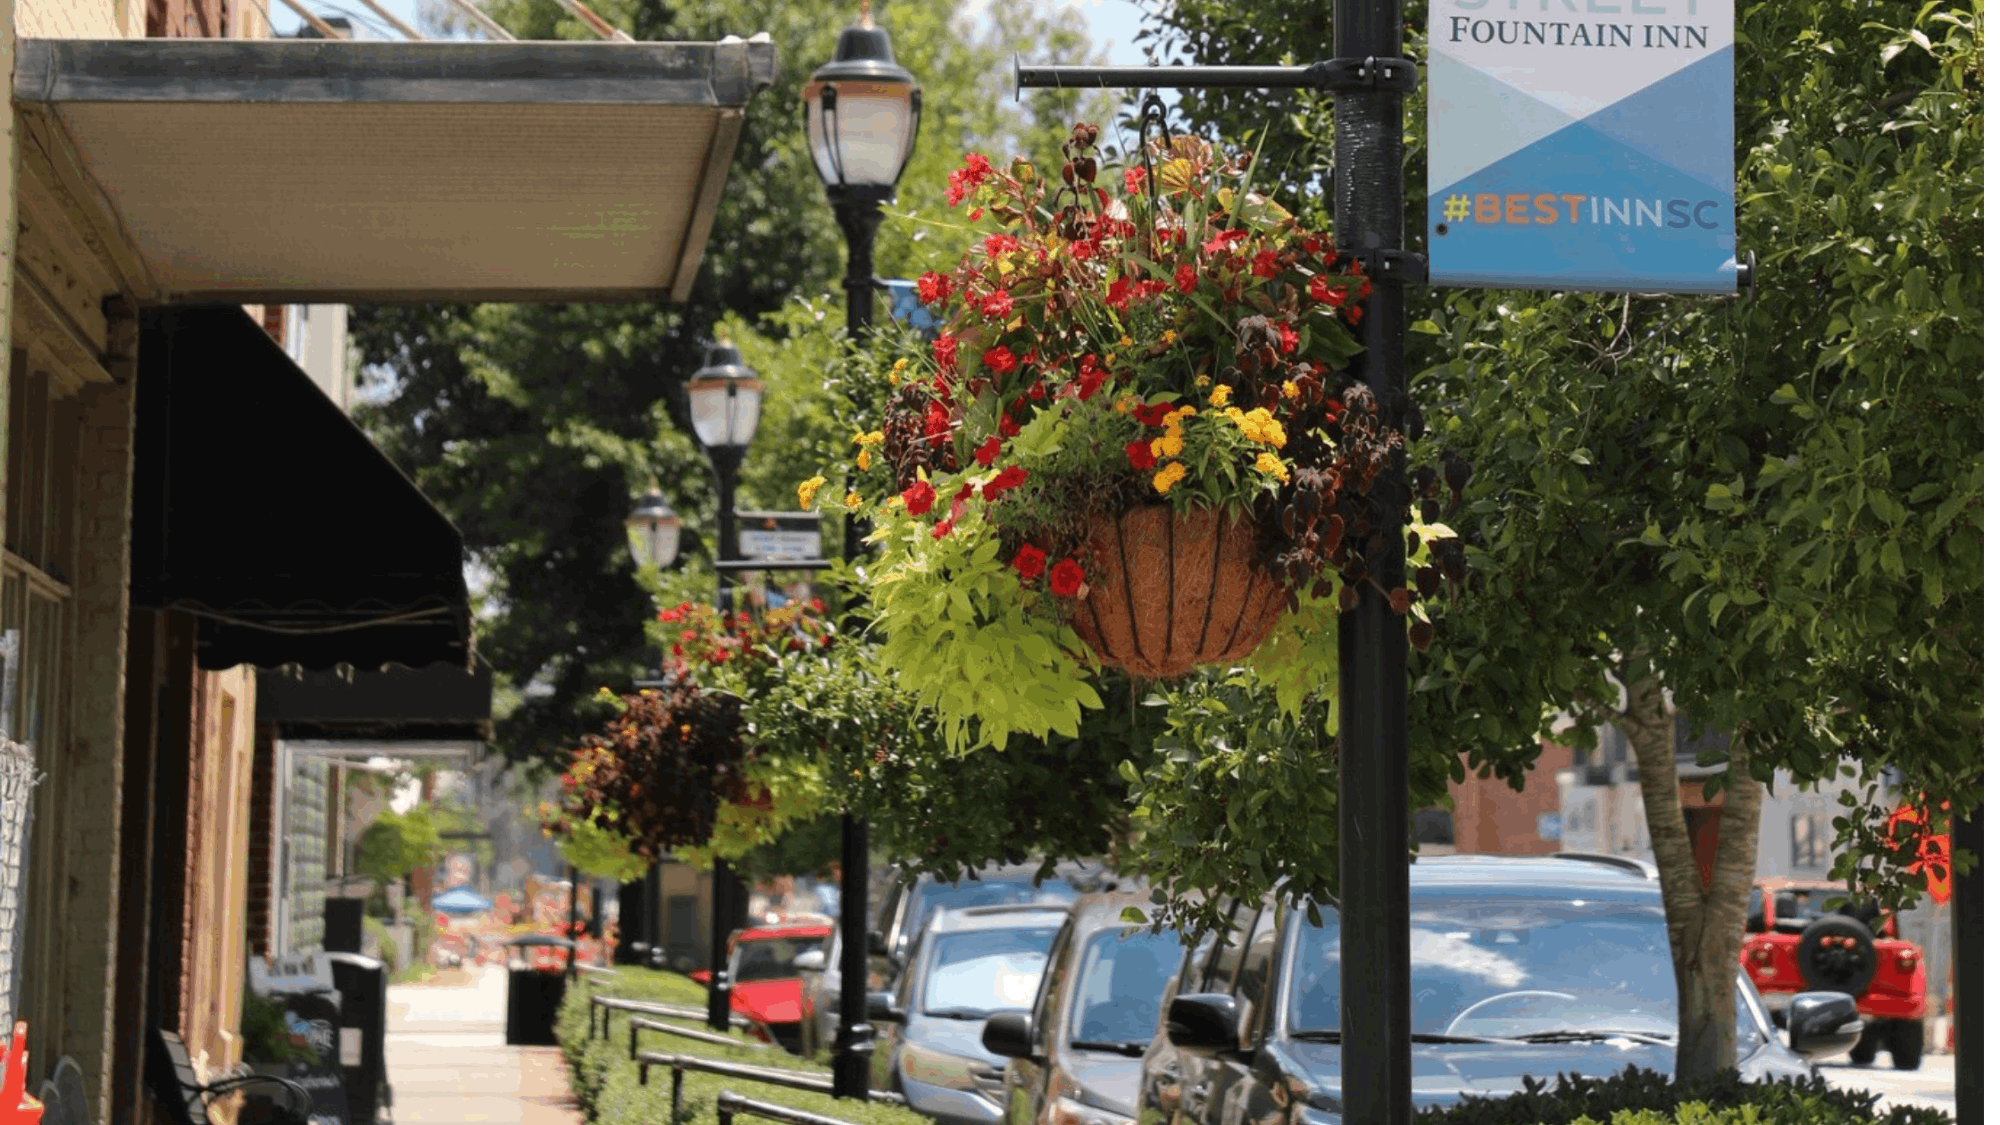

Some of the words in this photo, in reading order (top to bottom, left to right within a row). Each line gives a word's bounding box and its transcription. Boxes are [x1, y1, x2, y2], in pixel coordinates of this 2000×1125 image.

[1449, 16, 1633, 47] FOUNTAIN
[1643, 25, 1709, 48] INN
[1443, 194, 1719, 229] #BESTINNSC
